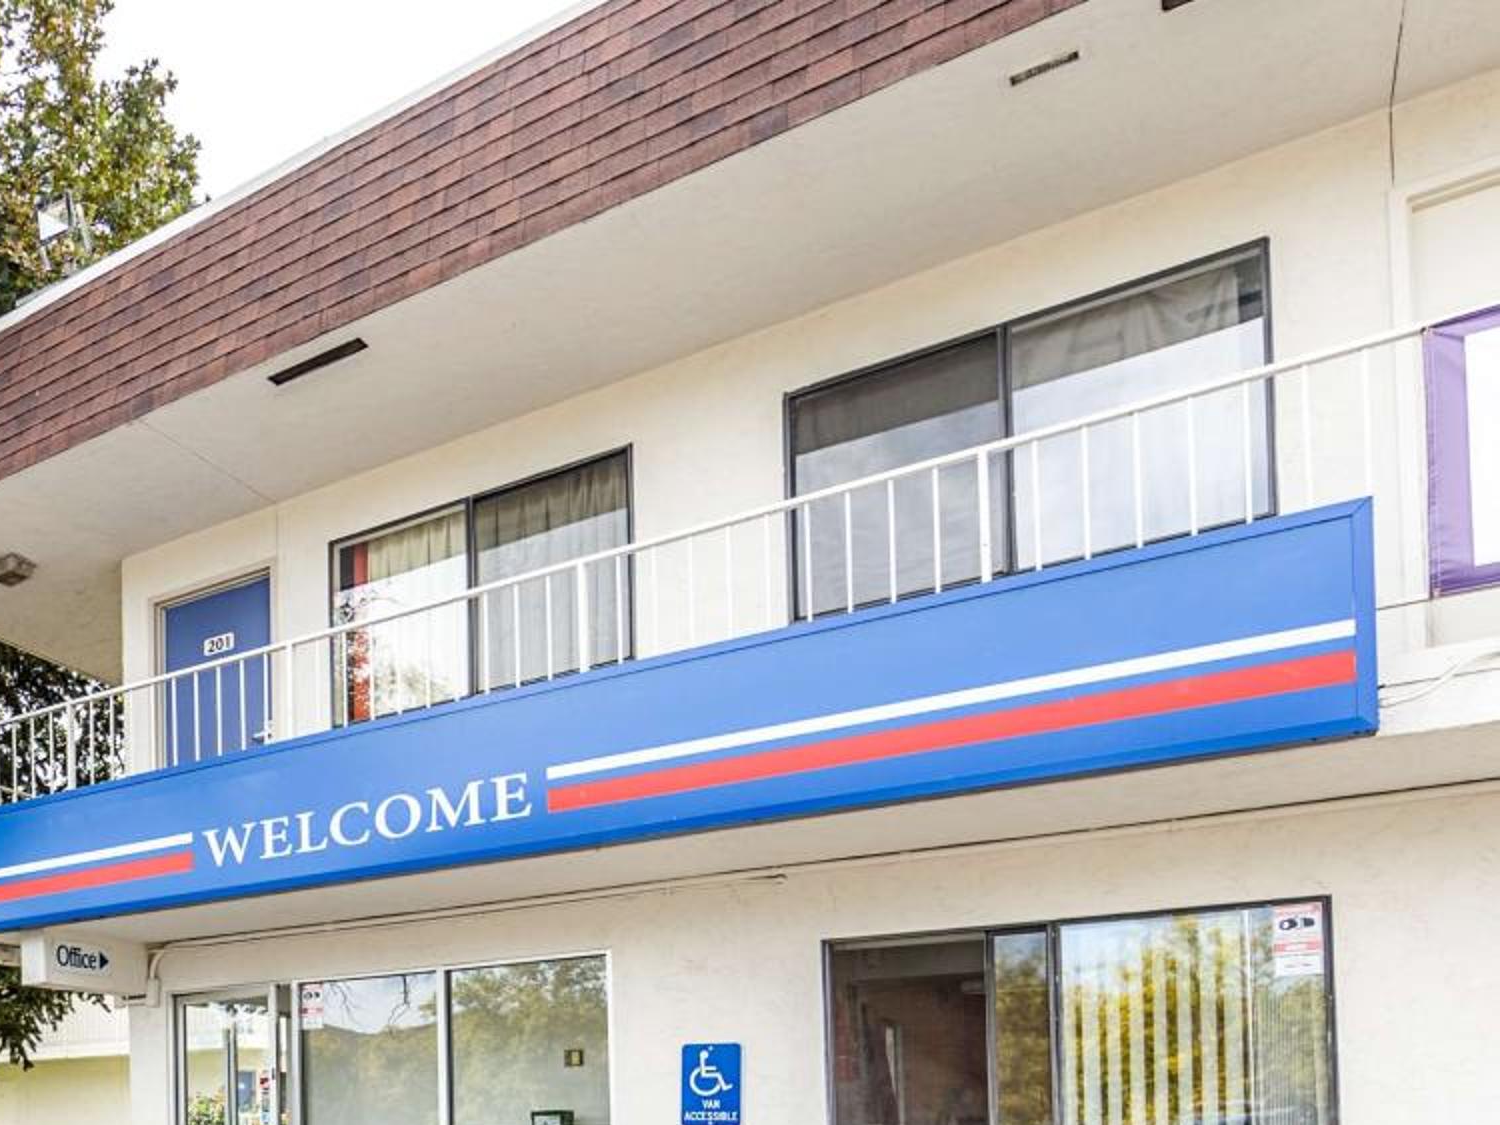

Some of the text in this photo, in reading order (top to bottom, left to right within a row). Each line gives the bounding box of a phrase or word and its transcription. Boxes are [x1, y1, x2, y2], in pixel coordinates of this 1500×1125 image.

[207, 635, 229, 653] 201
[203, 773, 532, 867] WELCOME
[56, 944, 97, 970] Office
[701, 1099, 721, 1109] VAN
[684, 1111, 738, 1121] ACCESSIBLE
